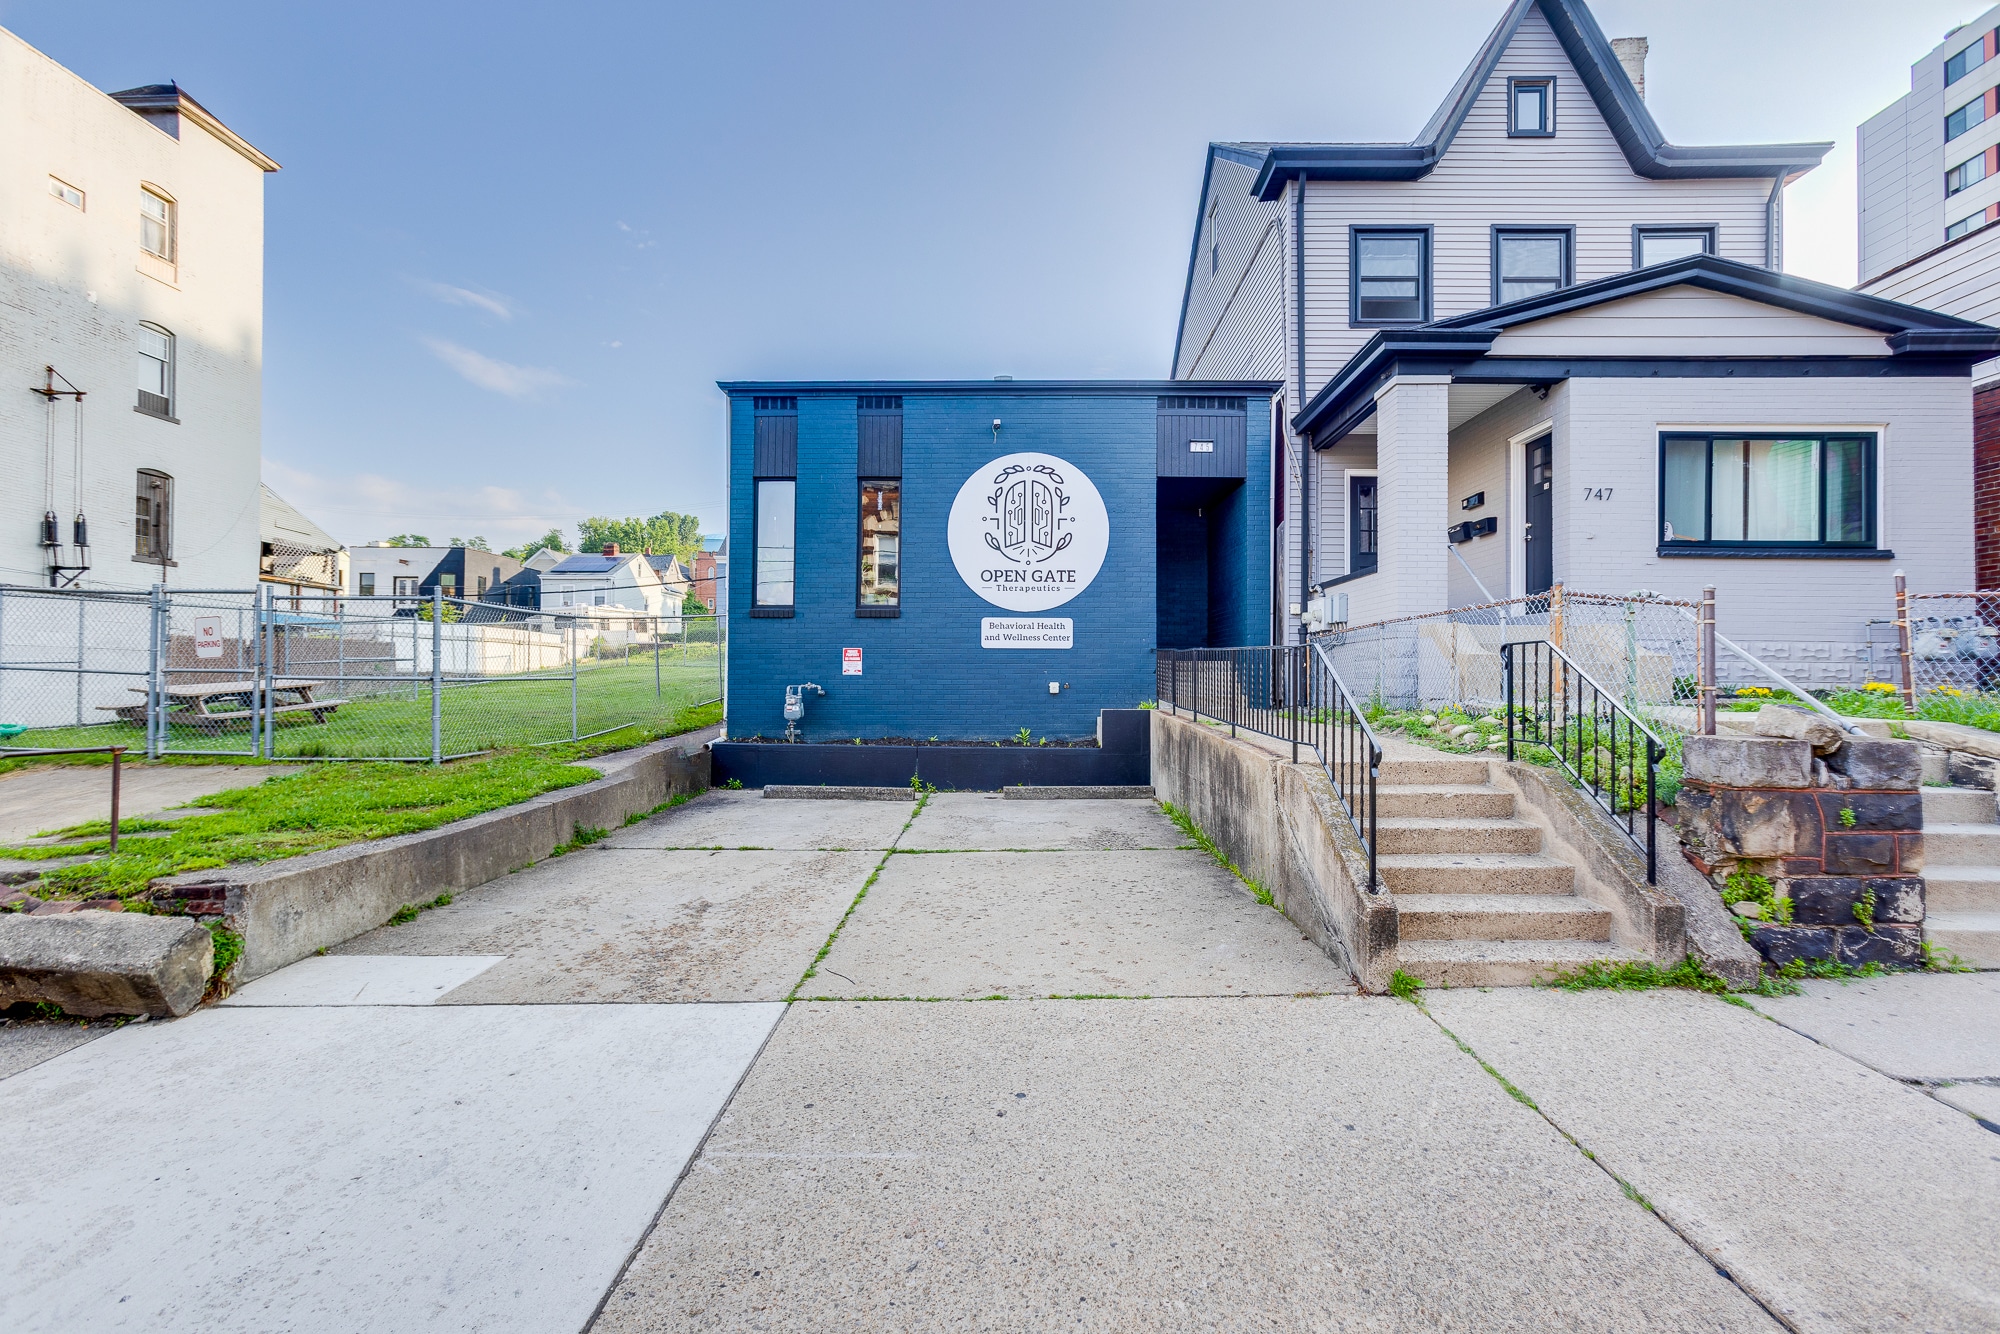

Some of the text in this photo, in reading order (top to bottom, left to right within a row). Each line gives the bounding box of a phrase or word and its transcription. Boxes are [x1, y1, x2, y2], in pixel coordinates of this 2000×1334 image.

[1584, 487, 1613, 501] 747
[980, 569, 1076, 583] OPEN GATE
[996, 584, 1061, 593] Therapeutics
[989, 622, 1066, 630] Behavioral Health
[203, 626, 213, 636] NO
[984, 633, 1071, 642] and Wellness Center
[197, 640, 221, 648] PARKING
